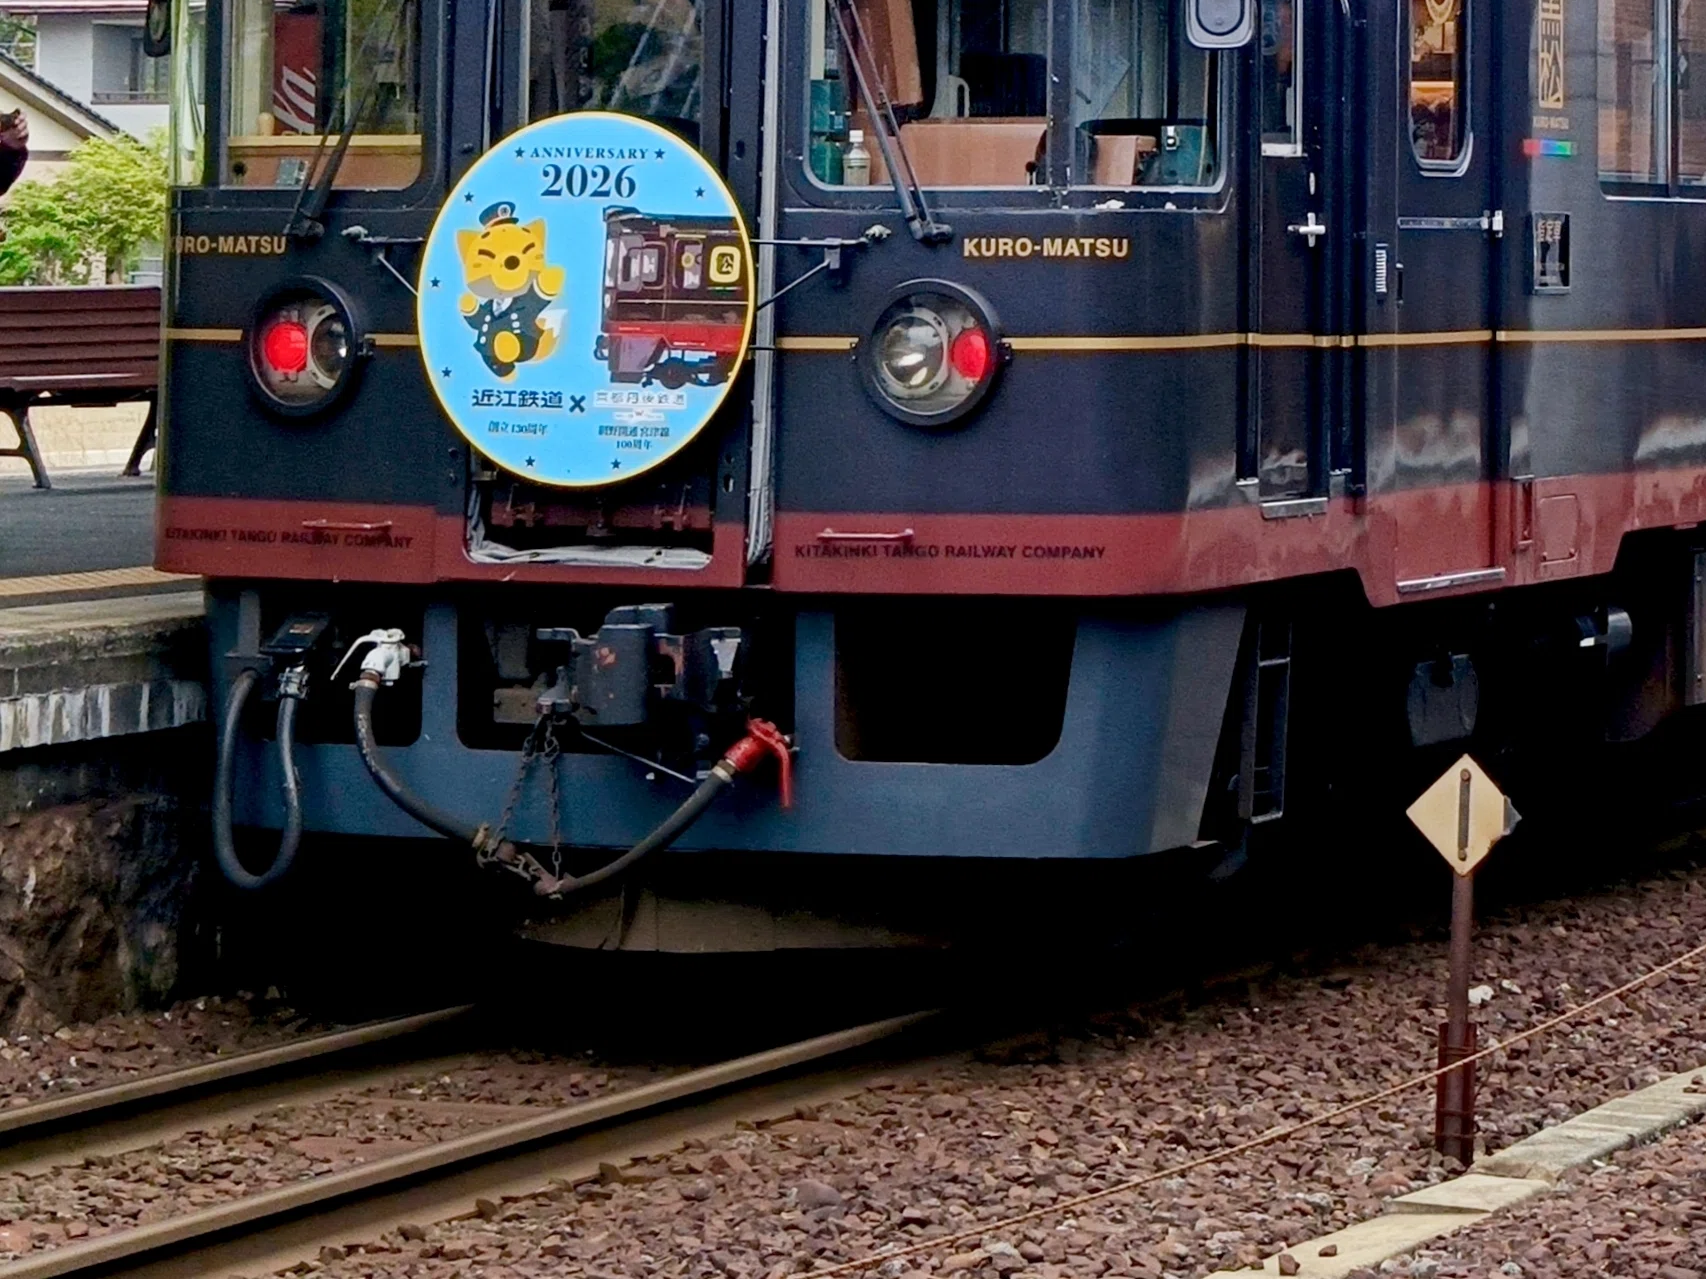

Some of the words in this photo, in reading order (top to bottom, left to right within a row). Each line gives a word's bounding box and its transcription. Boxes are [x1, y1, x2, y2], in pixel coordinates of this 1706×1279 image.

[529, 146, 650, 161] ANNIVERSARY
[540, 163, 636, 199] 2026
[963, 236, 1129, 259] KURO-MATSU
[471, 389, 564, 411] 近江鉄道
[344, 533, 413, 550] COMPANY
[795, 543, 878, 558] KITAKINKI
[882, 544, 940, 559] TANGO
[945, 544, 1016, 559] RAILWAY
[1022, 544, 1107, 560] COMPANY
